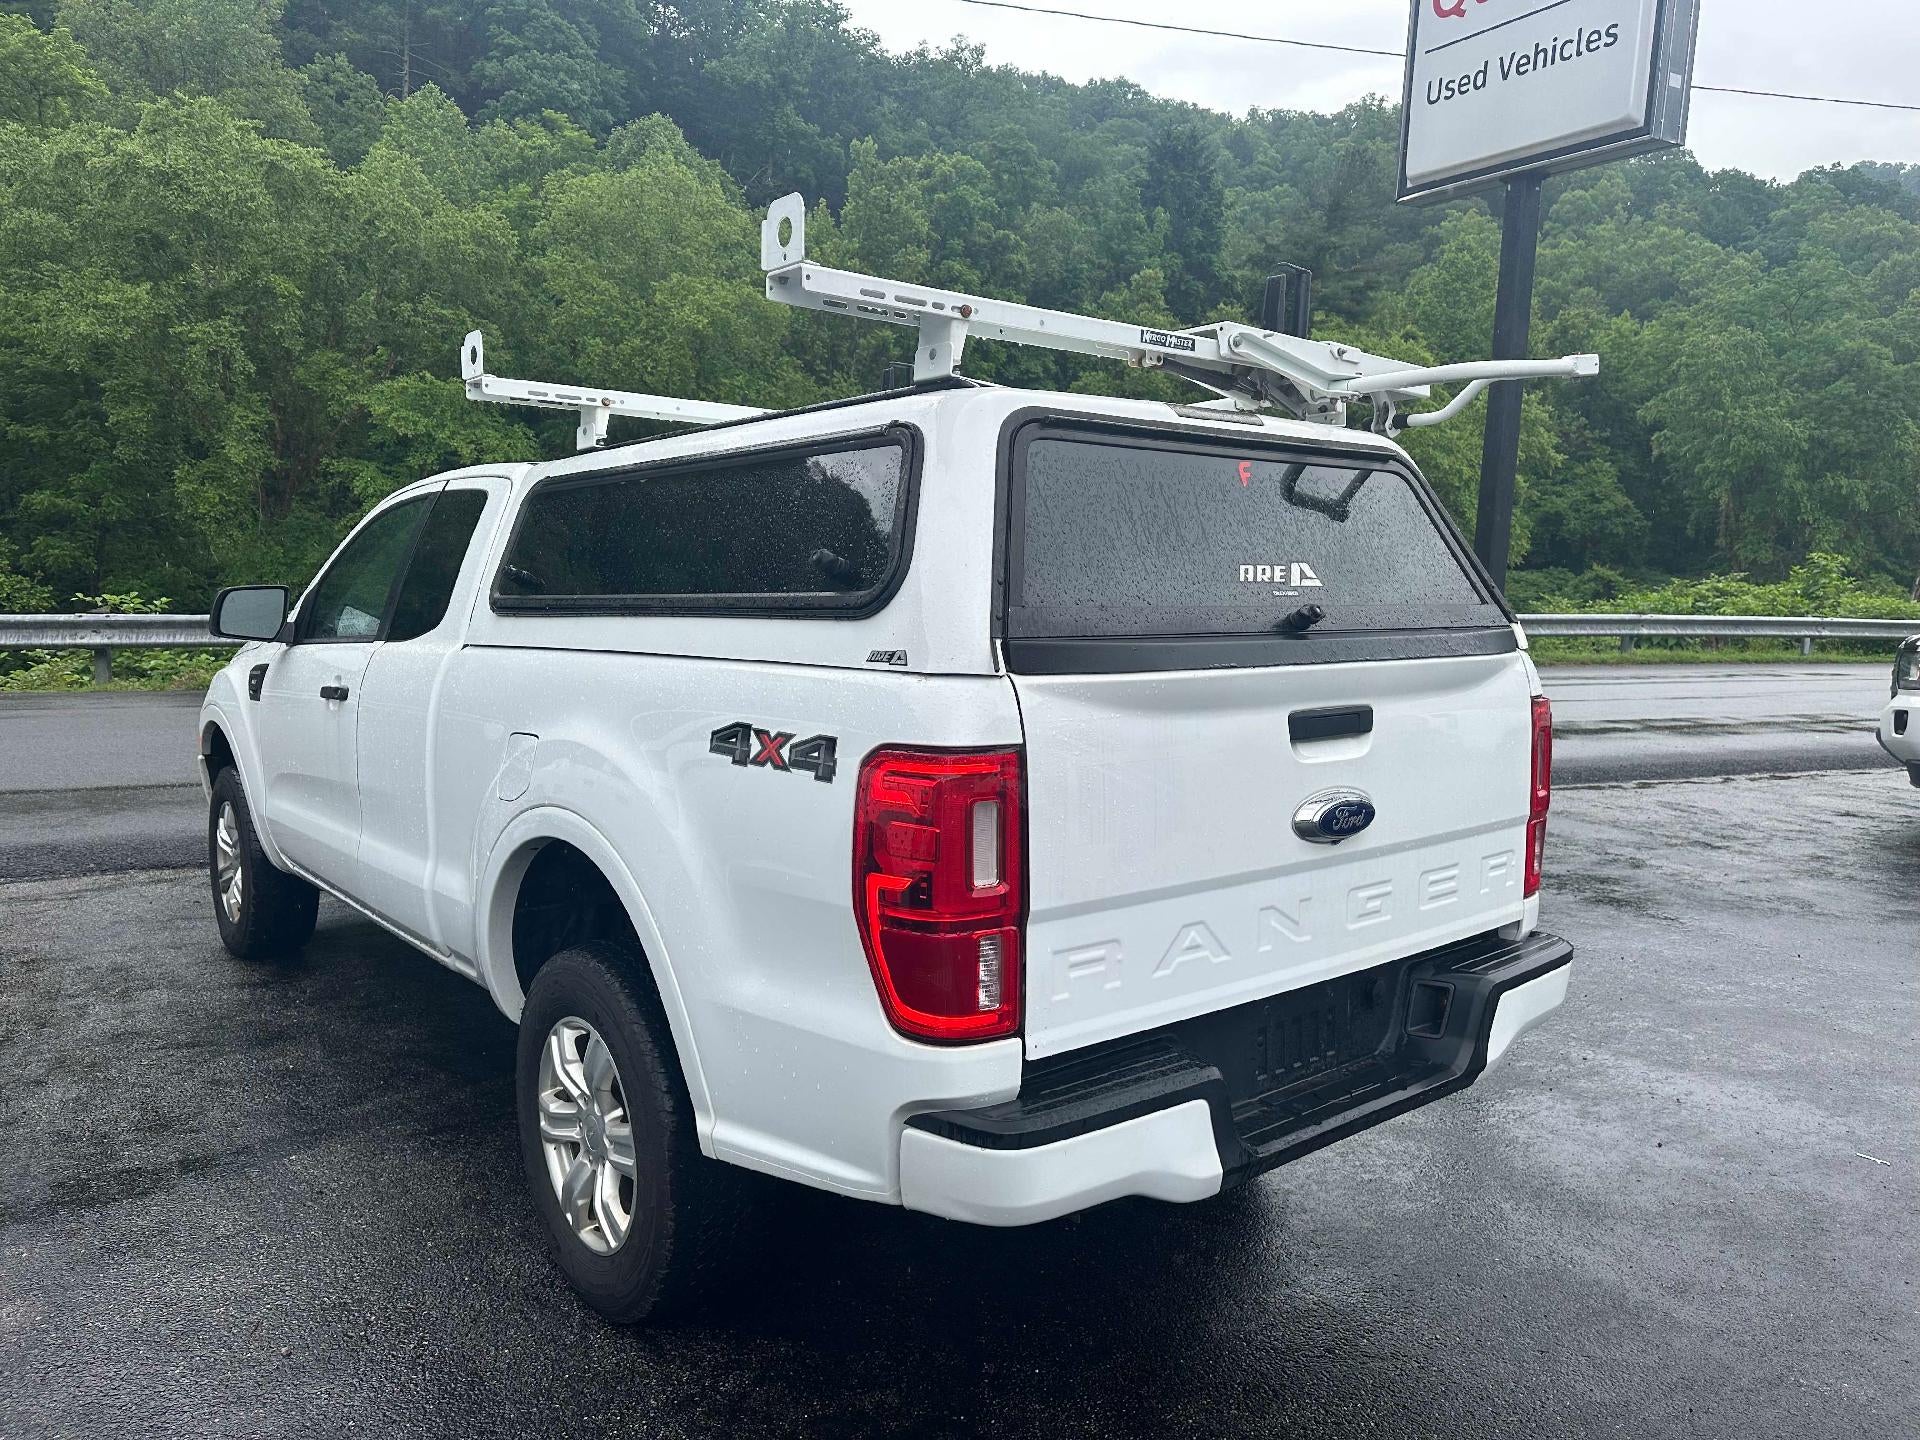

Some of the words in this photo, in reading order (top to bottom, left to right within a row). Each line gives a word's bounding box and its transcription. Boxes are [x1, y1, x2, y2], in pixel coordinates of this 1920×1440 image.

[1426, 60, 1488, 105] Used
[1499, 23, 1619, 81] Vehicles
[1332, 805, 1366, 831] Ford
[1050, 848, 1516, 1001] RANGER
